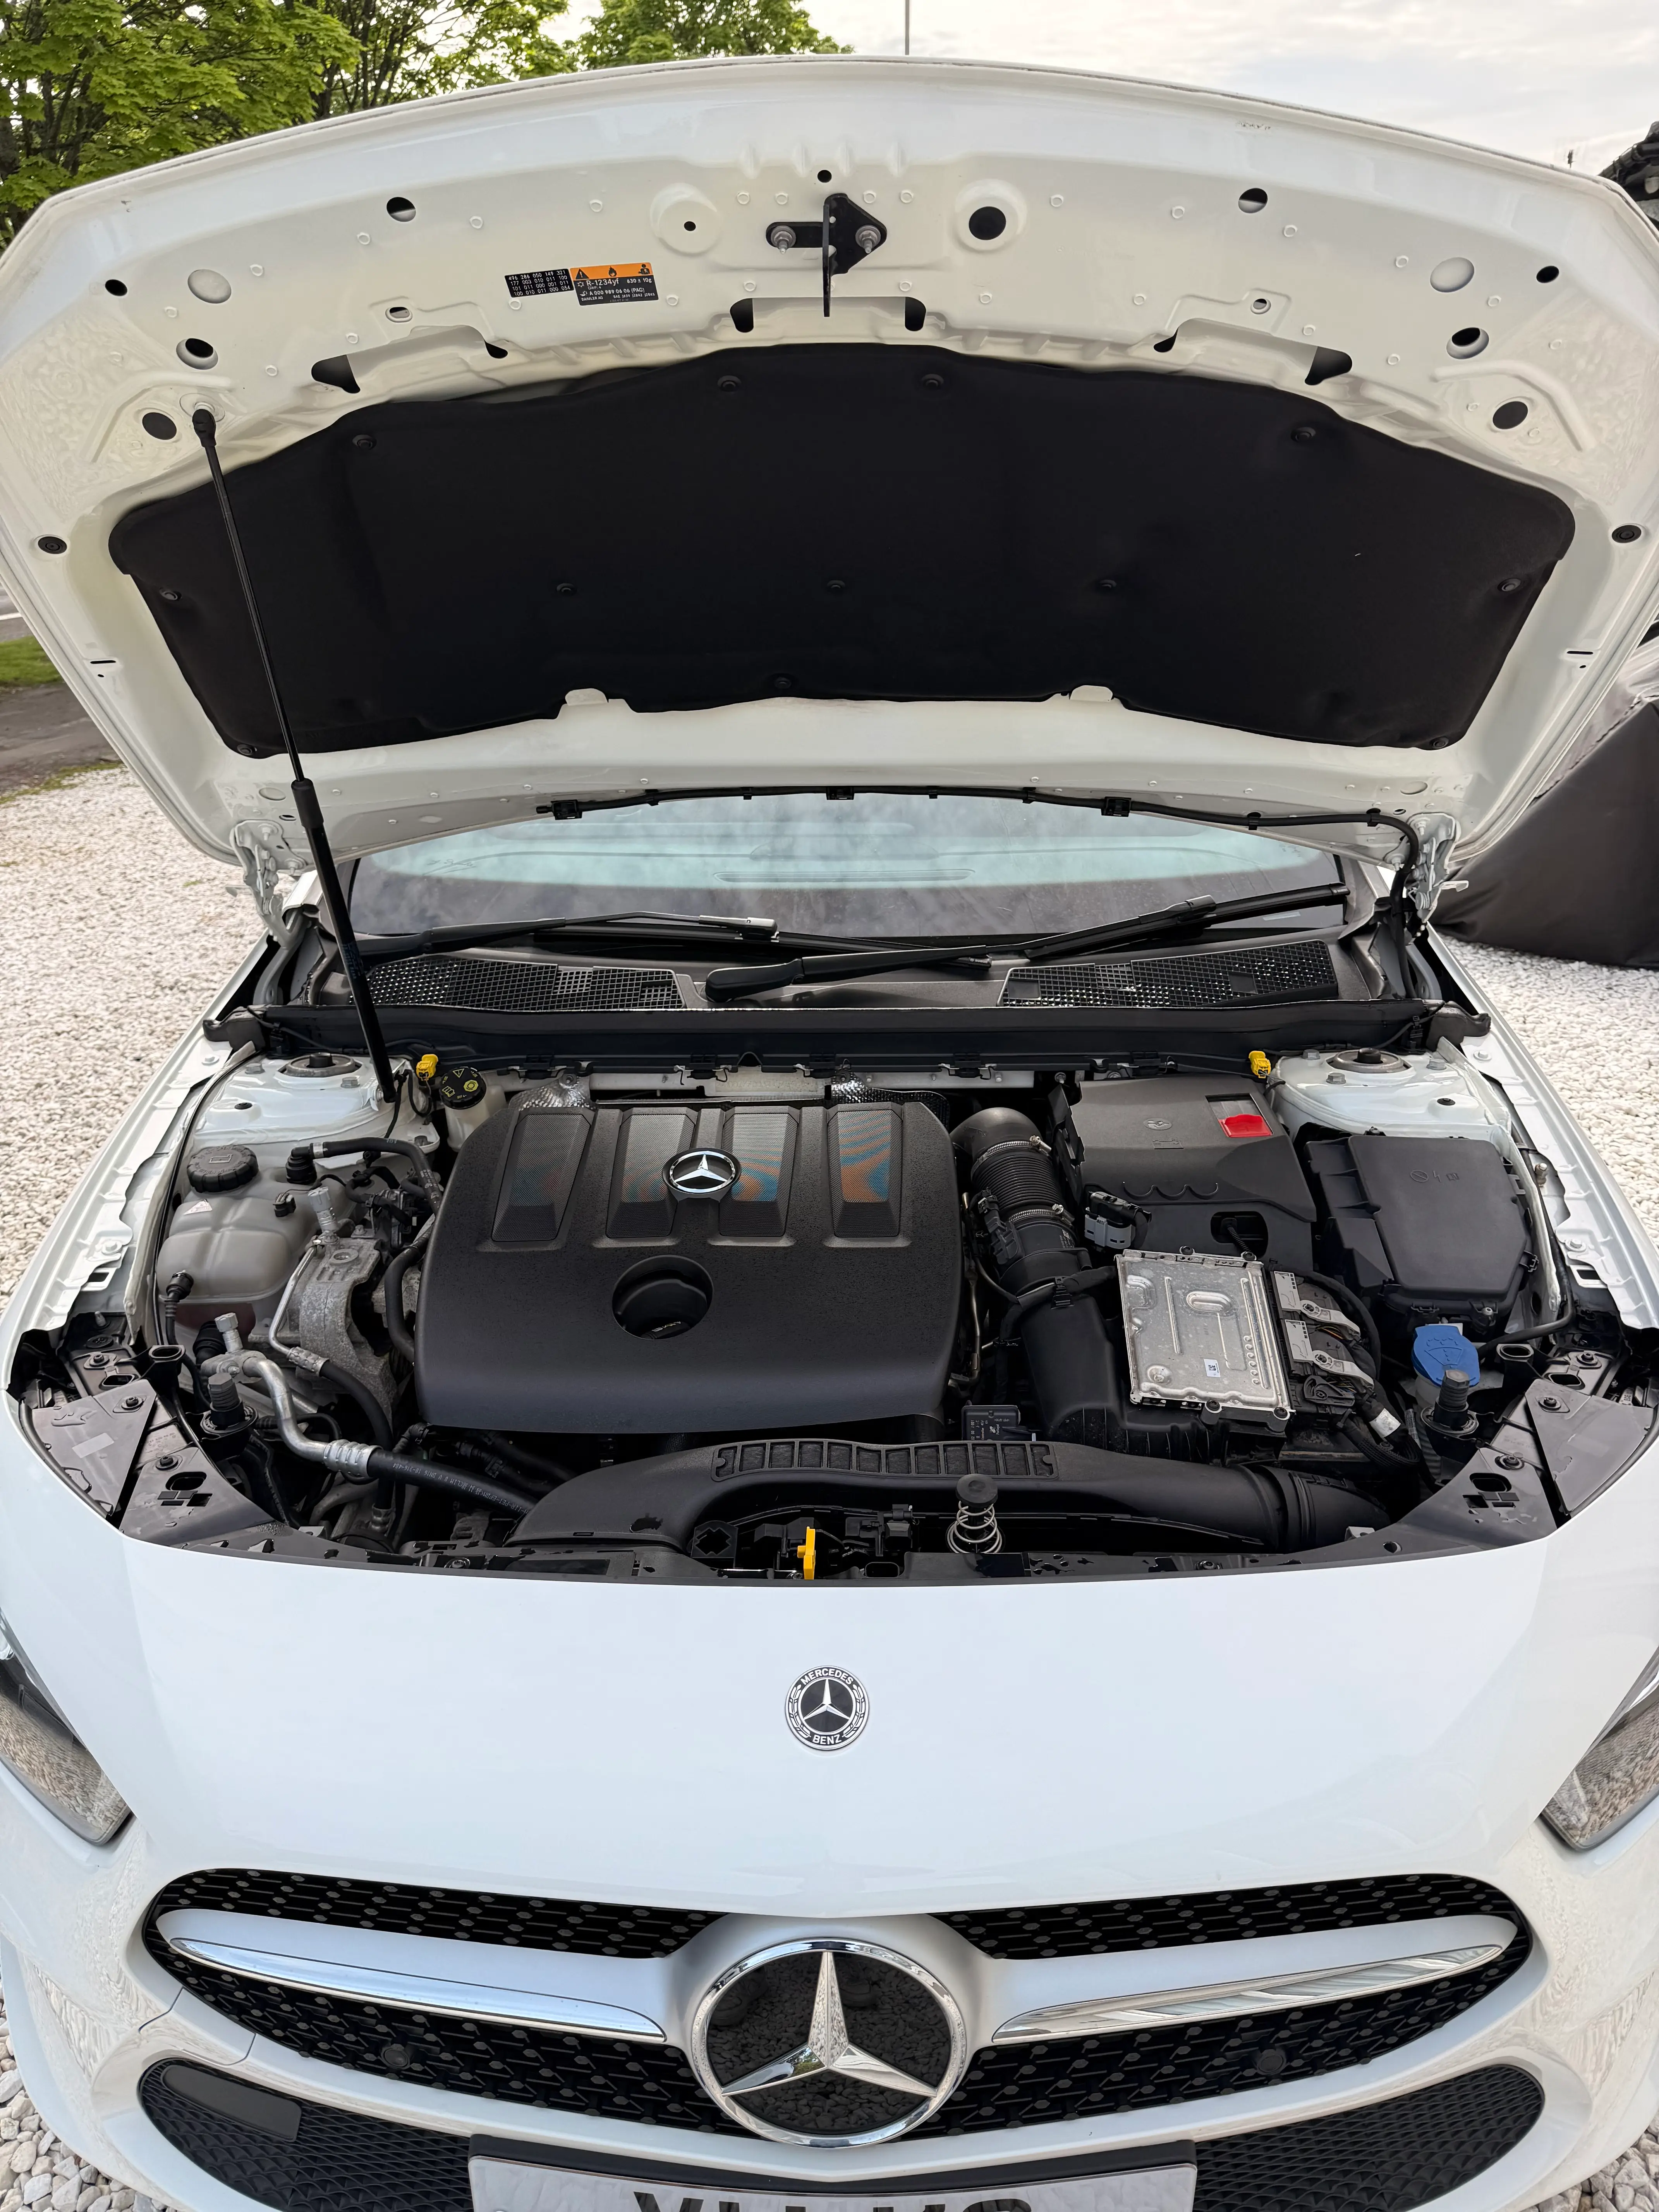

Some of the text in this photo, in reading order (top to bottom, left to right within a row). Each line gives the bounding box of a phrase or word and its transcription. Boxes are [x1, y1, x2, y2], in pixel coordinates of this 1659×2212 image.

[586, 278, 619, 287] R-1234yf
[800, 1668, 854, 1685] MERCEDES
[812, 1734, 842, 1745] BENZ
